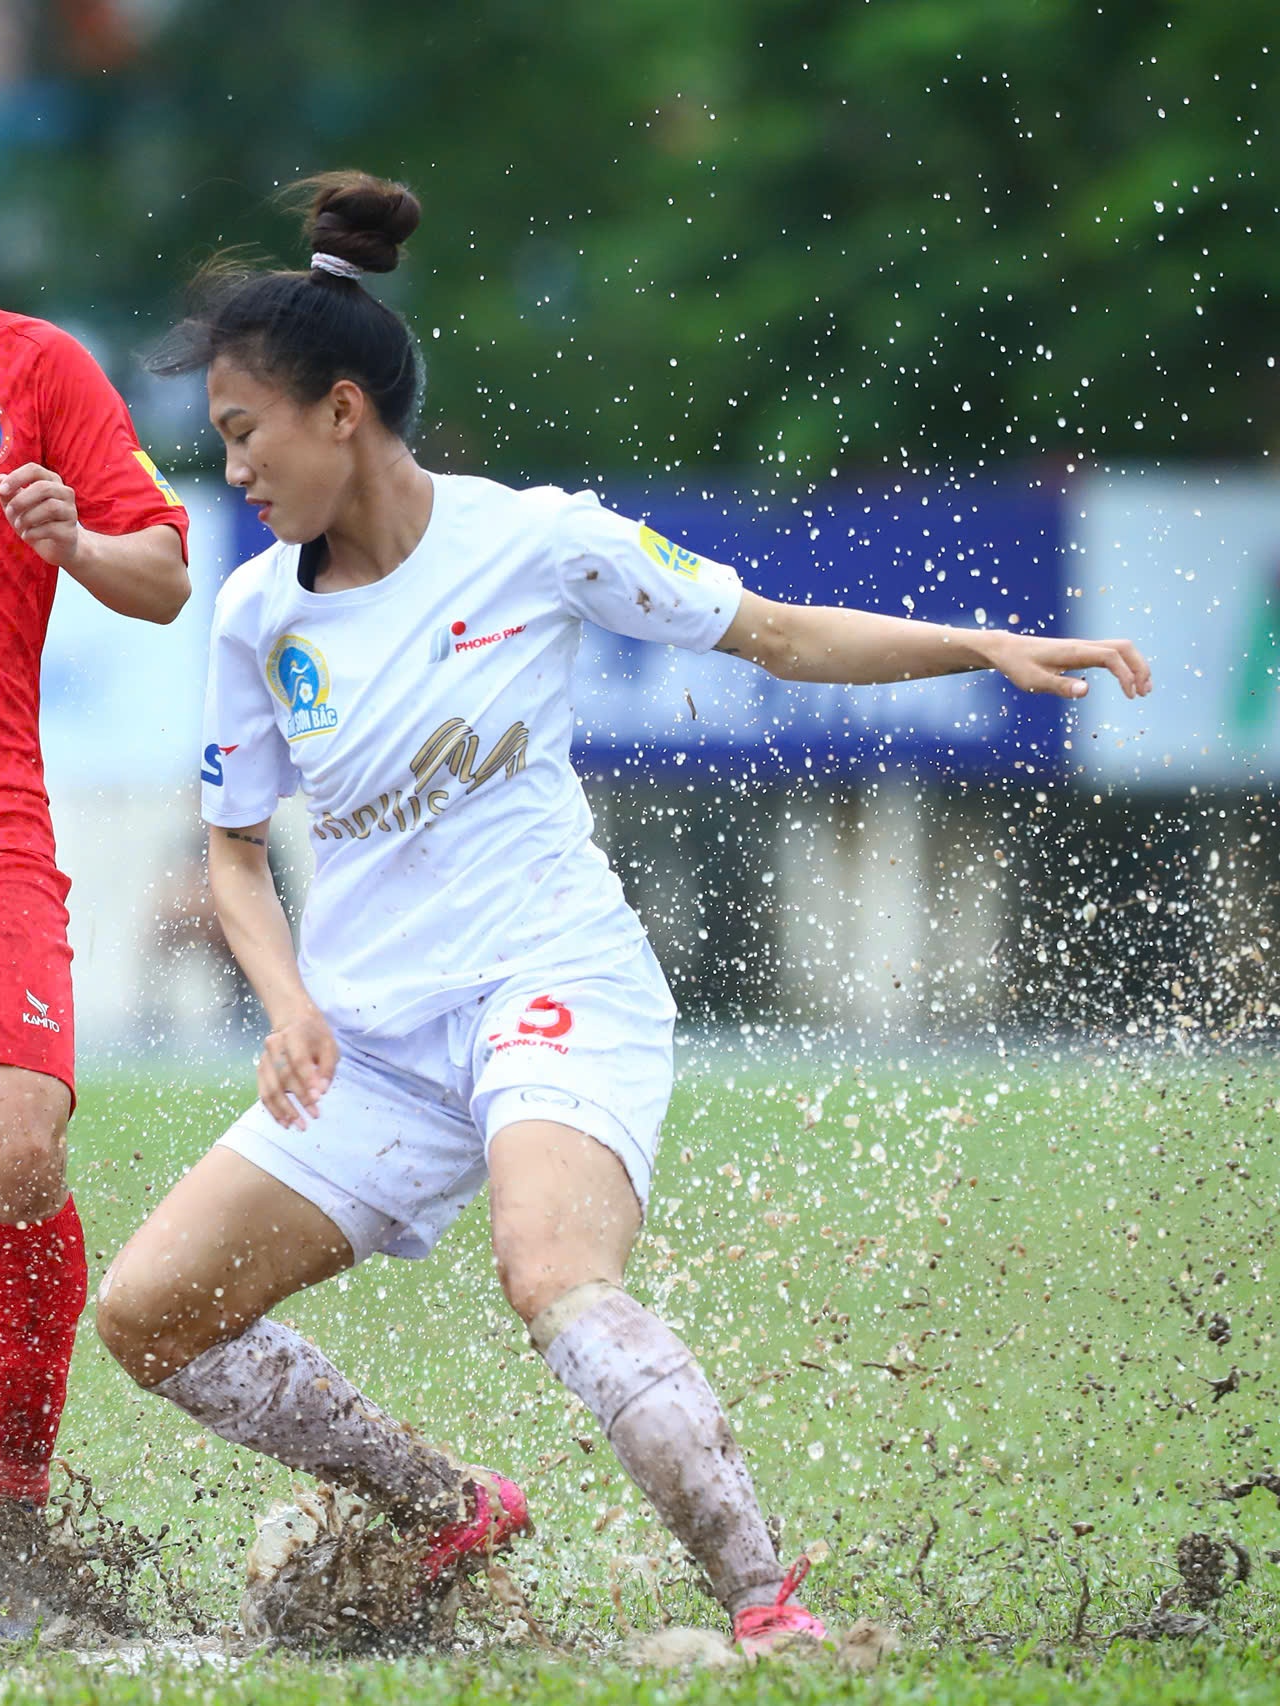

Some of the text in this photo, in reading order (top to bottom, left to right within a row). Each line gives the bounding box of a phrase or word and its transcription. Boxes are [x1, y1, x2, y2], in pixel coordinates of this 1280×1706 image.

[455, 633, 501, 653] PHONG
[311, 704, 336, 728] BẮC
[23, 1012, 60, 1033] KAMITO
